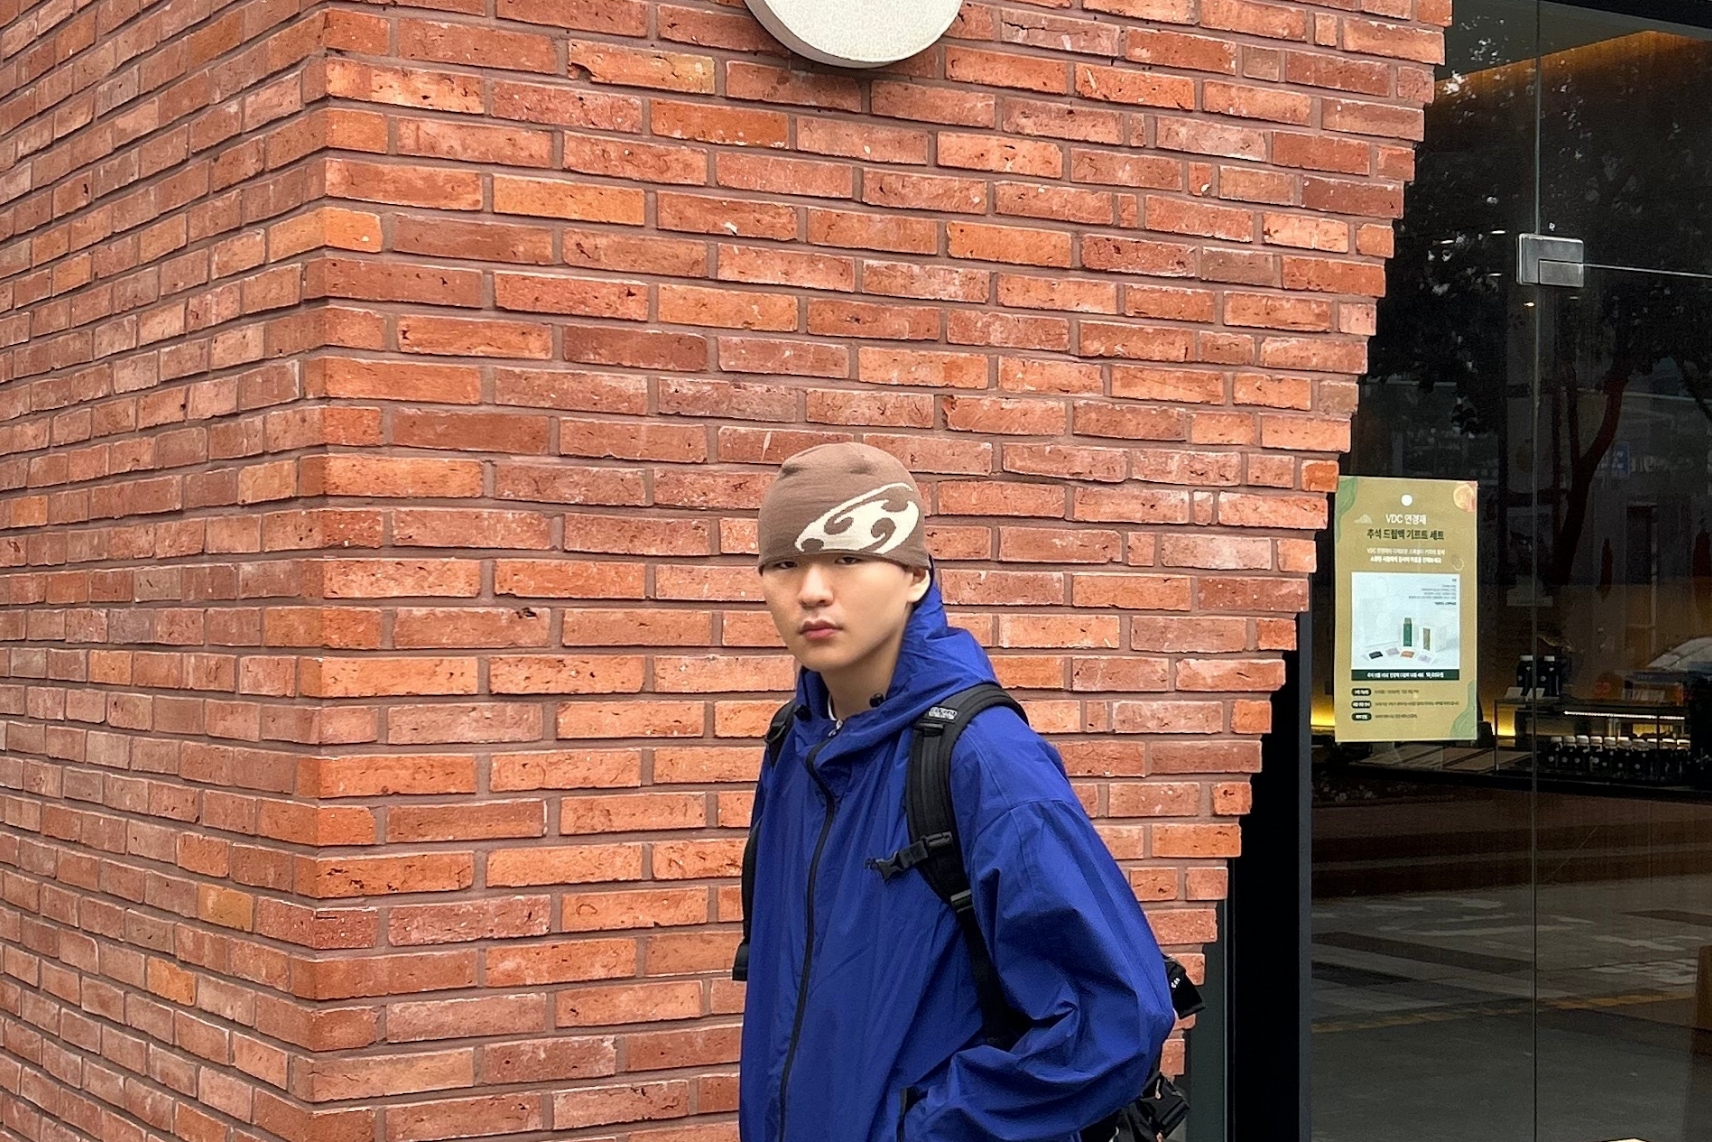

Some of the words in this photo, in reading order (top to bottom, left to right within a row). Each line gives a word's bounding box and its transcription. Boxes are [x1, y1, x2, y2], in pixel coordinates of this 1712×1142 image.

[1385, 514, 1403, 524] VDC
[1367, 528, 1382, 539] 추석
[1383, 528, 1405, 540] 드립백
[1406, 529, 1428, 540] 기프트
[1430, 530, 1445, 540] 세트
